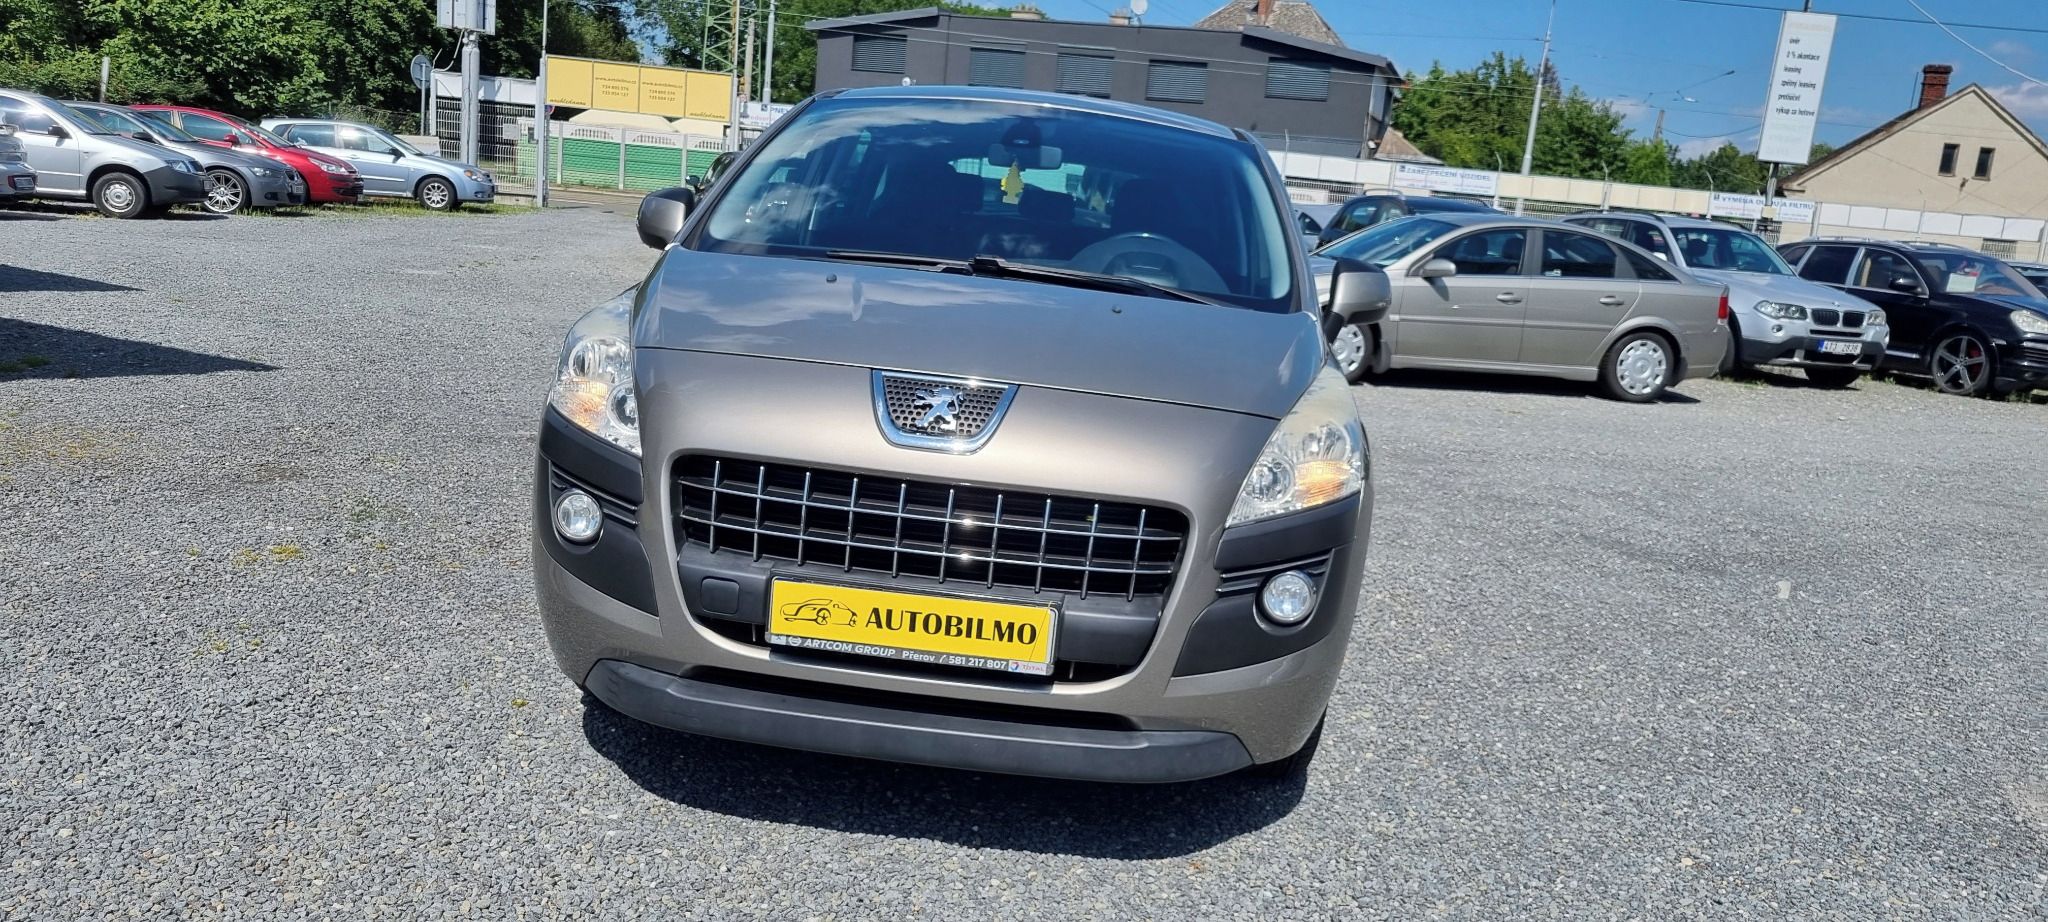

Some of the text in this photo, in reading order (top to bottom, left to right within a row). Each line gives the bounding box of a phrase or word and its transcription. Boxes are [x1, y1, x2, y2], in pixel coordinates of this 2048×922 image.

[865, 607, 1037, 645] AUTOBILMO
[804, 638, 852, 652] ARTCOM
[855, 645, 896, 657] GROUP
[902, 650, 935, 662] Přerov
[948, 655, 966, 665] 581
[968, 657, 985, 667] 217
[986, 660, 1007, 669] 807
[1021, 664, 1045, 672] TOTAL
